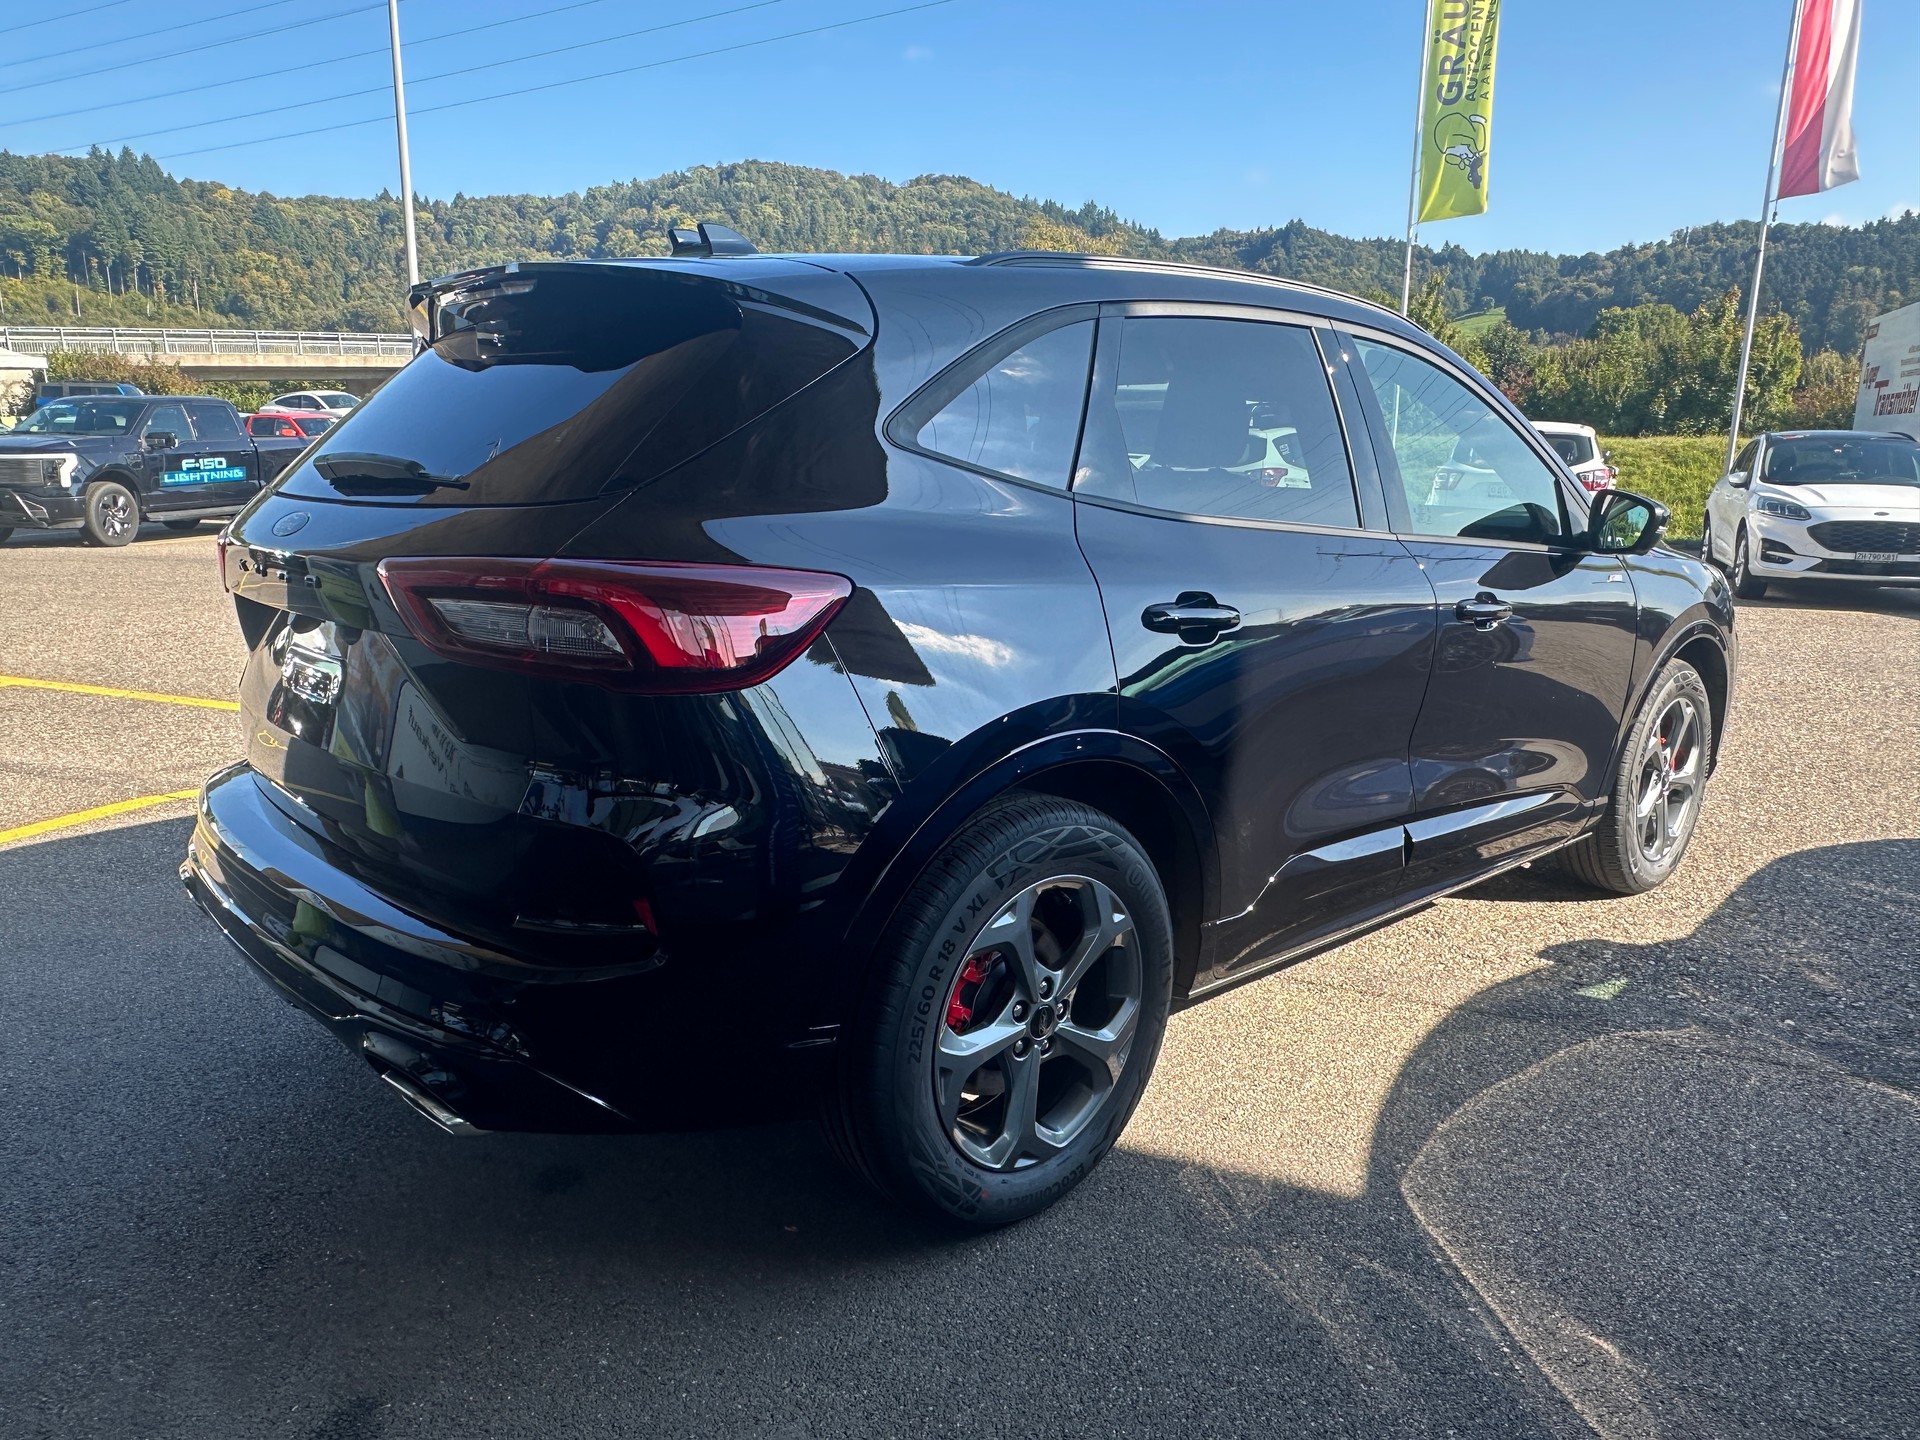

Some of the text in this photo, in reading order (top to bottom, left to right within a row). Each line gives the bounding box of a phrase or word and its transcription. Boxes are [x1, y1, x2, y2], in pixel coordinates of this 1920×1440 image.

[1479, 34, 1494, 100] AARAU
[164, 469, 244, 483] LIGHTNING
[181, 457, 227, 471] F-150
[907, 893, 989, 1065] 225/60 R 18 V XL
